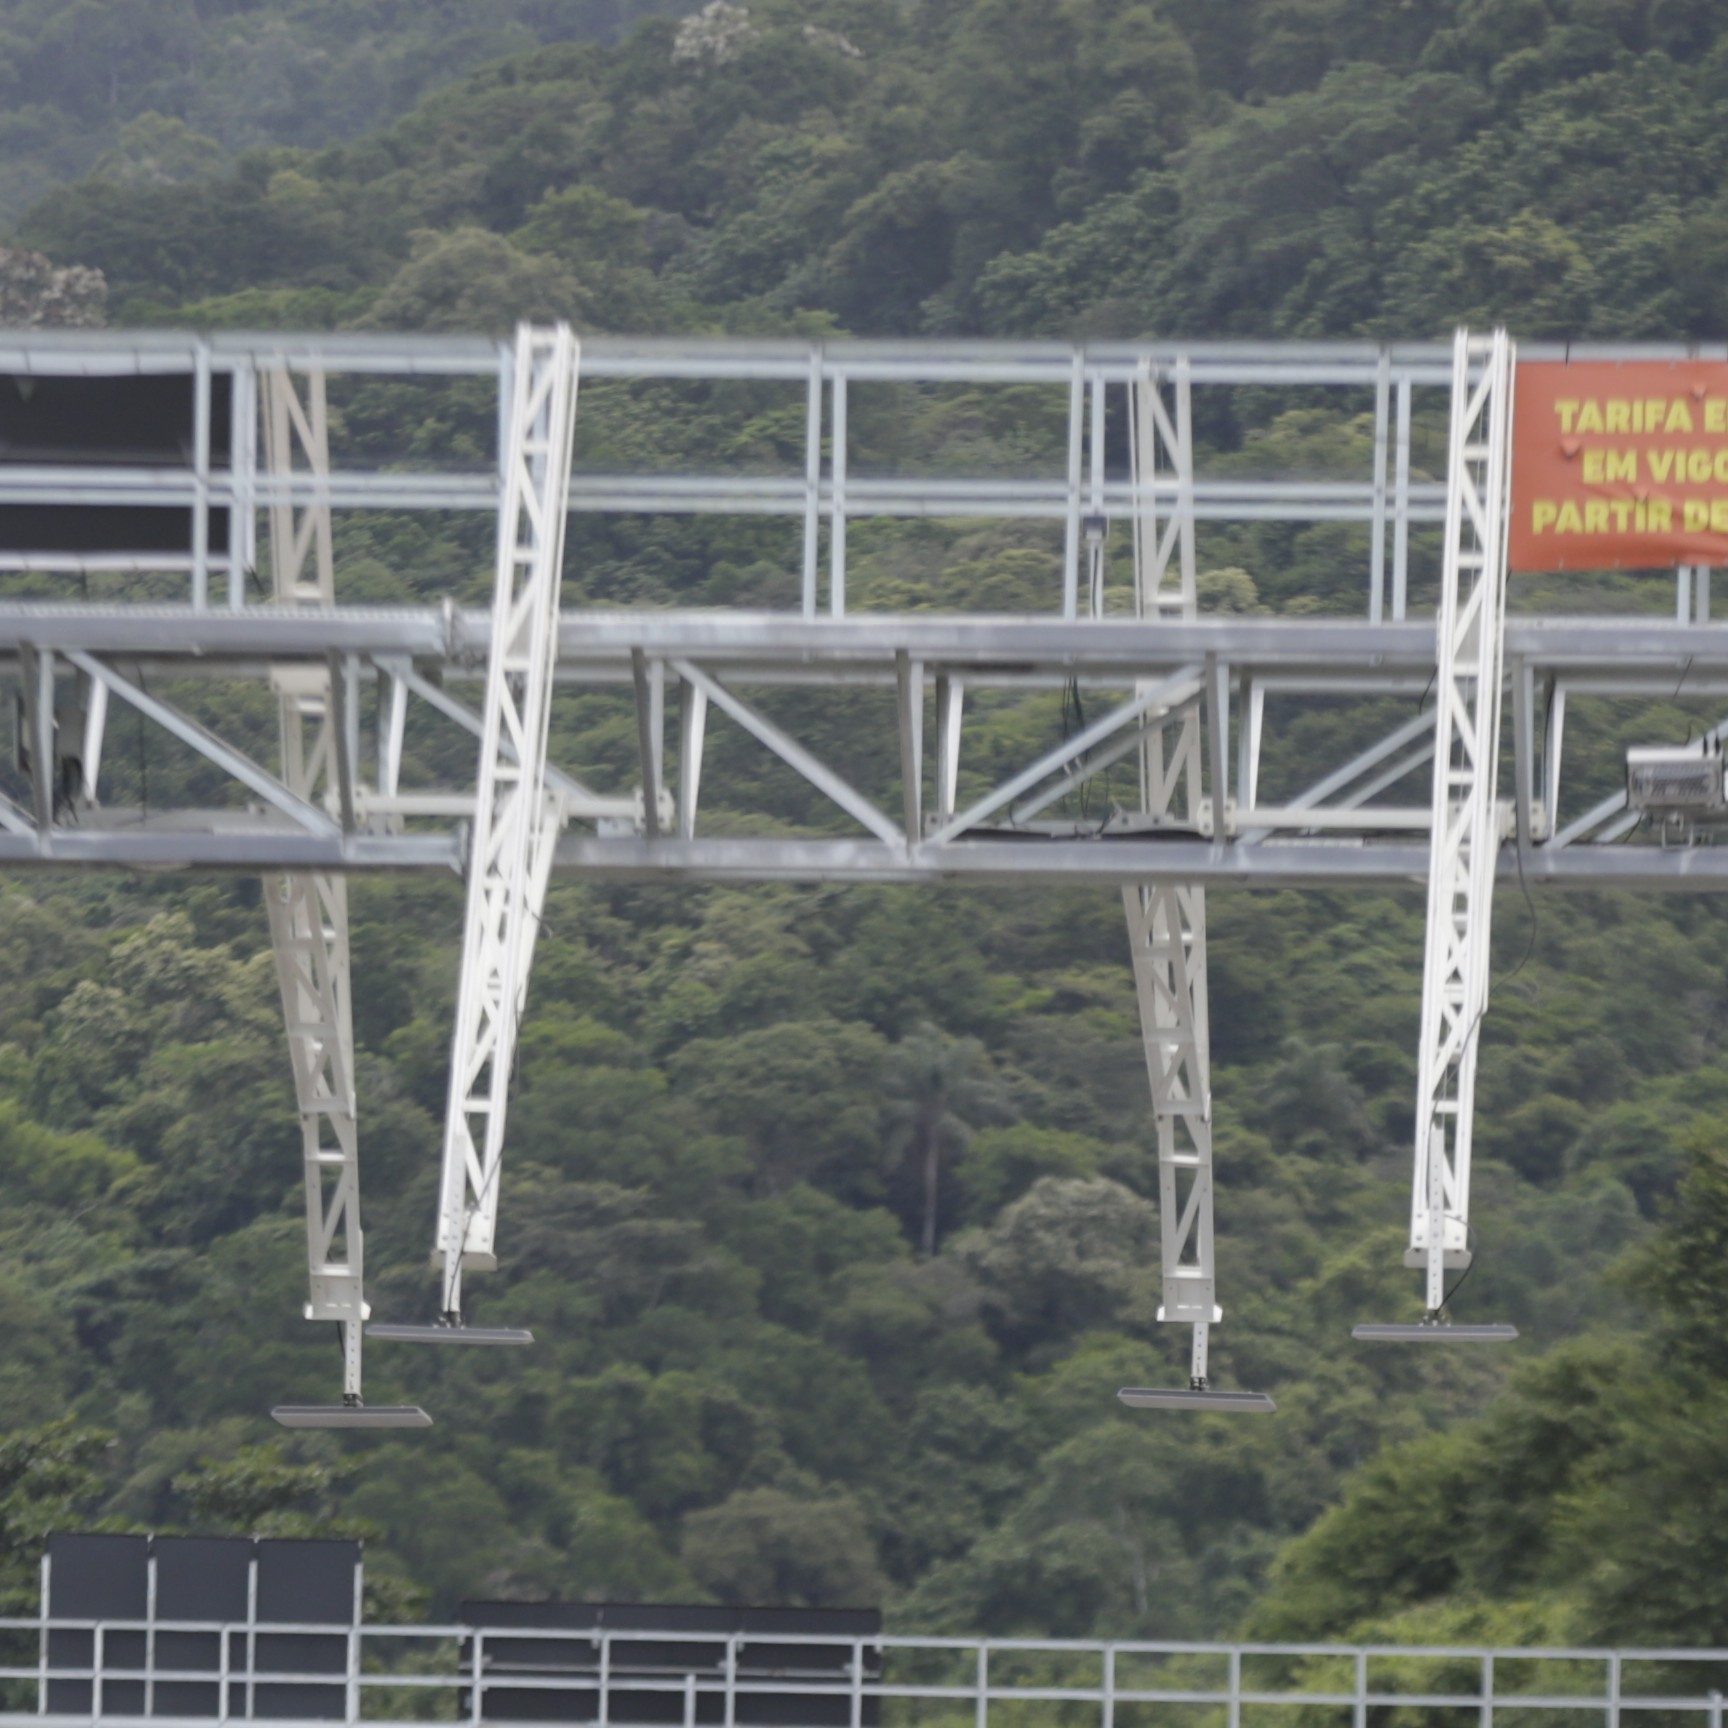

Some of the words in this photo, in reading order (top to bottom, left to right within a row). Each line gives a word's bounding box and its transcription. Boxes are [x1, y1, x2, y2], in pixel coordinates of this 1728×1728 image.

[1554, 397, 1693, 434] TARIFA
[1582, 448, 1637, 484] EM
[1532, 498, 1673, 535] PARTIR
